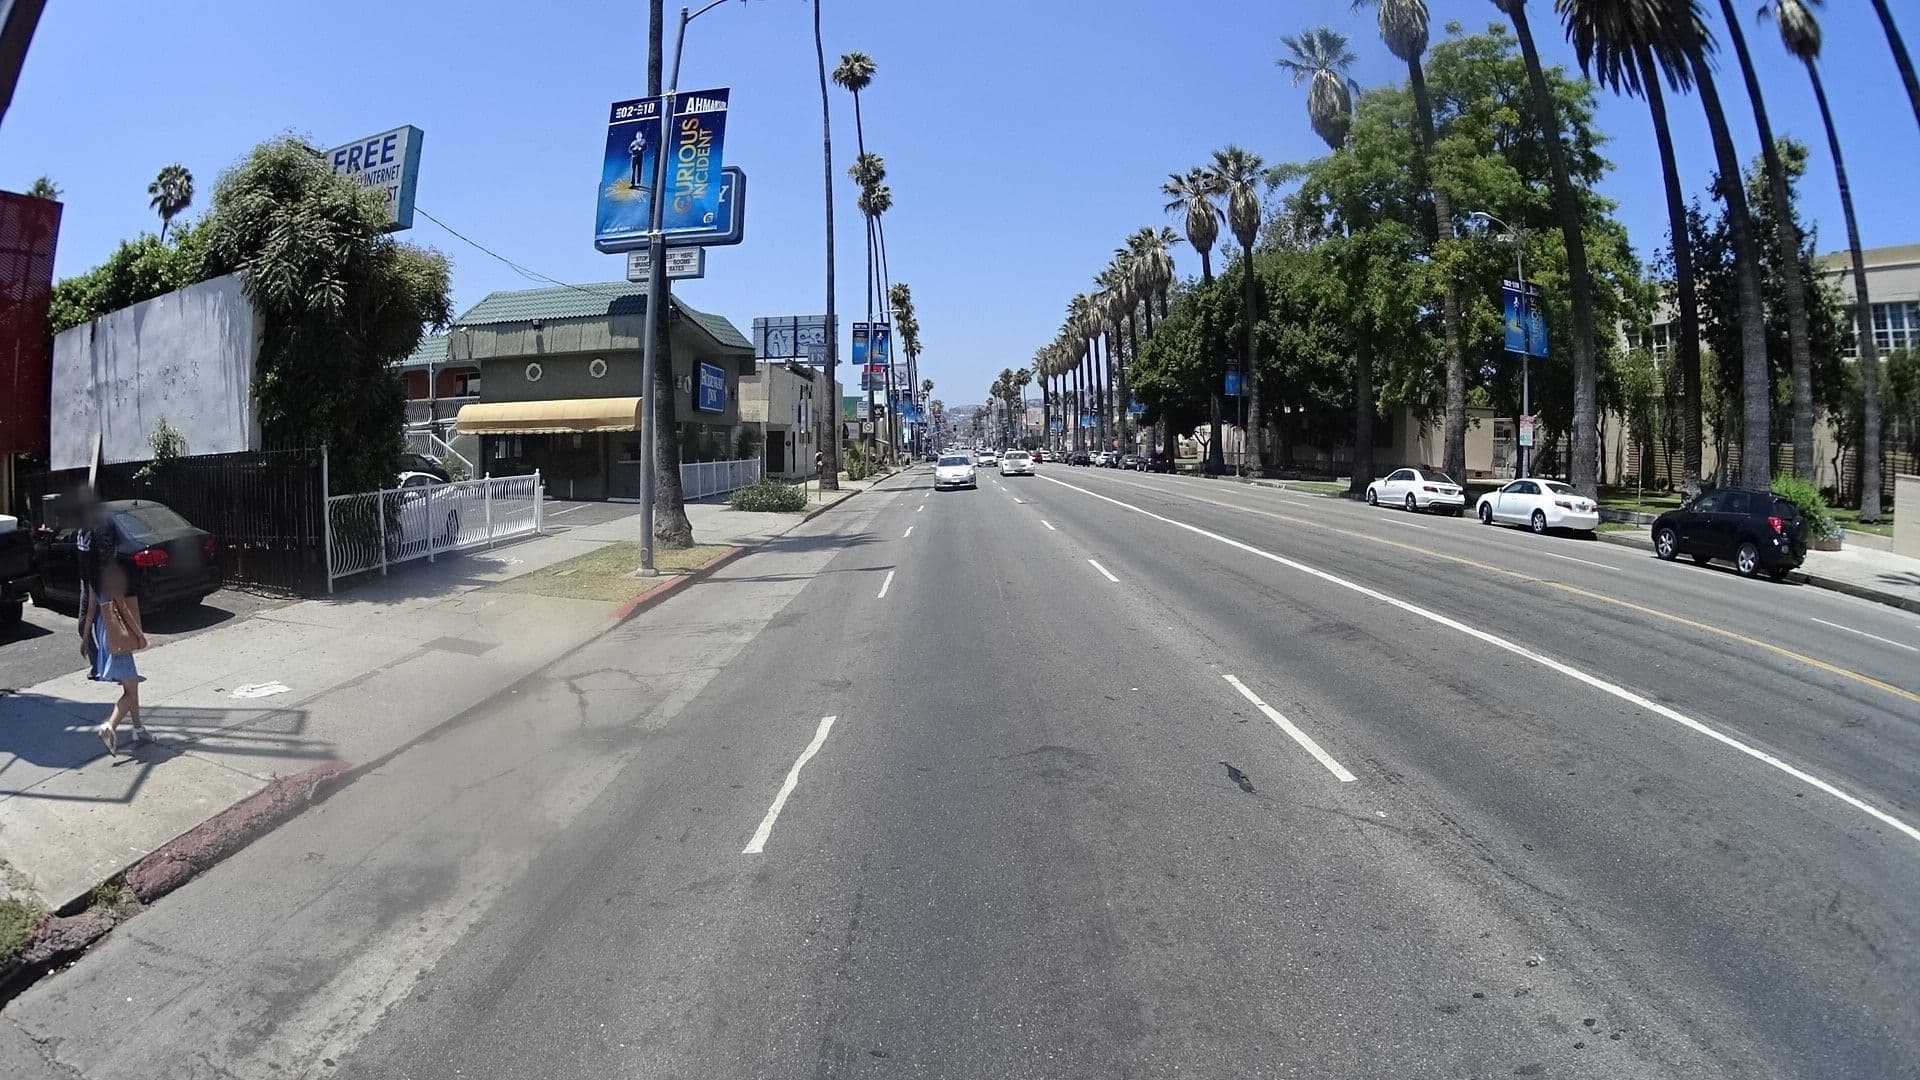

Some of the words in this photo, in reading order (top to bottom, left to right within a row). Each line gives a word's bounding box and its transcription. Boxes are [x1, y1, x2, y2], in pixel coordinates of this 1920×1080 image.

[332, 133, 398, 176] FREE
[364, 163, 401, 187] INTERNET
[673, 117, 700, 215] CURIOUS
[693, 128, 713, 199] INCIDENT
